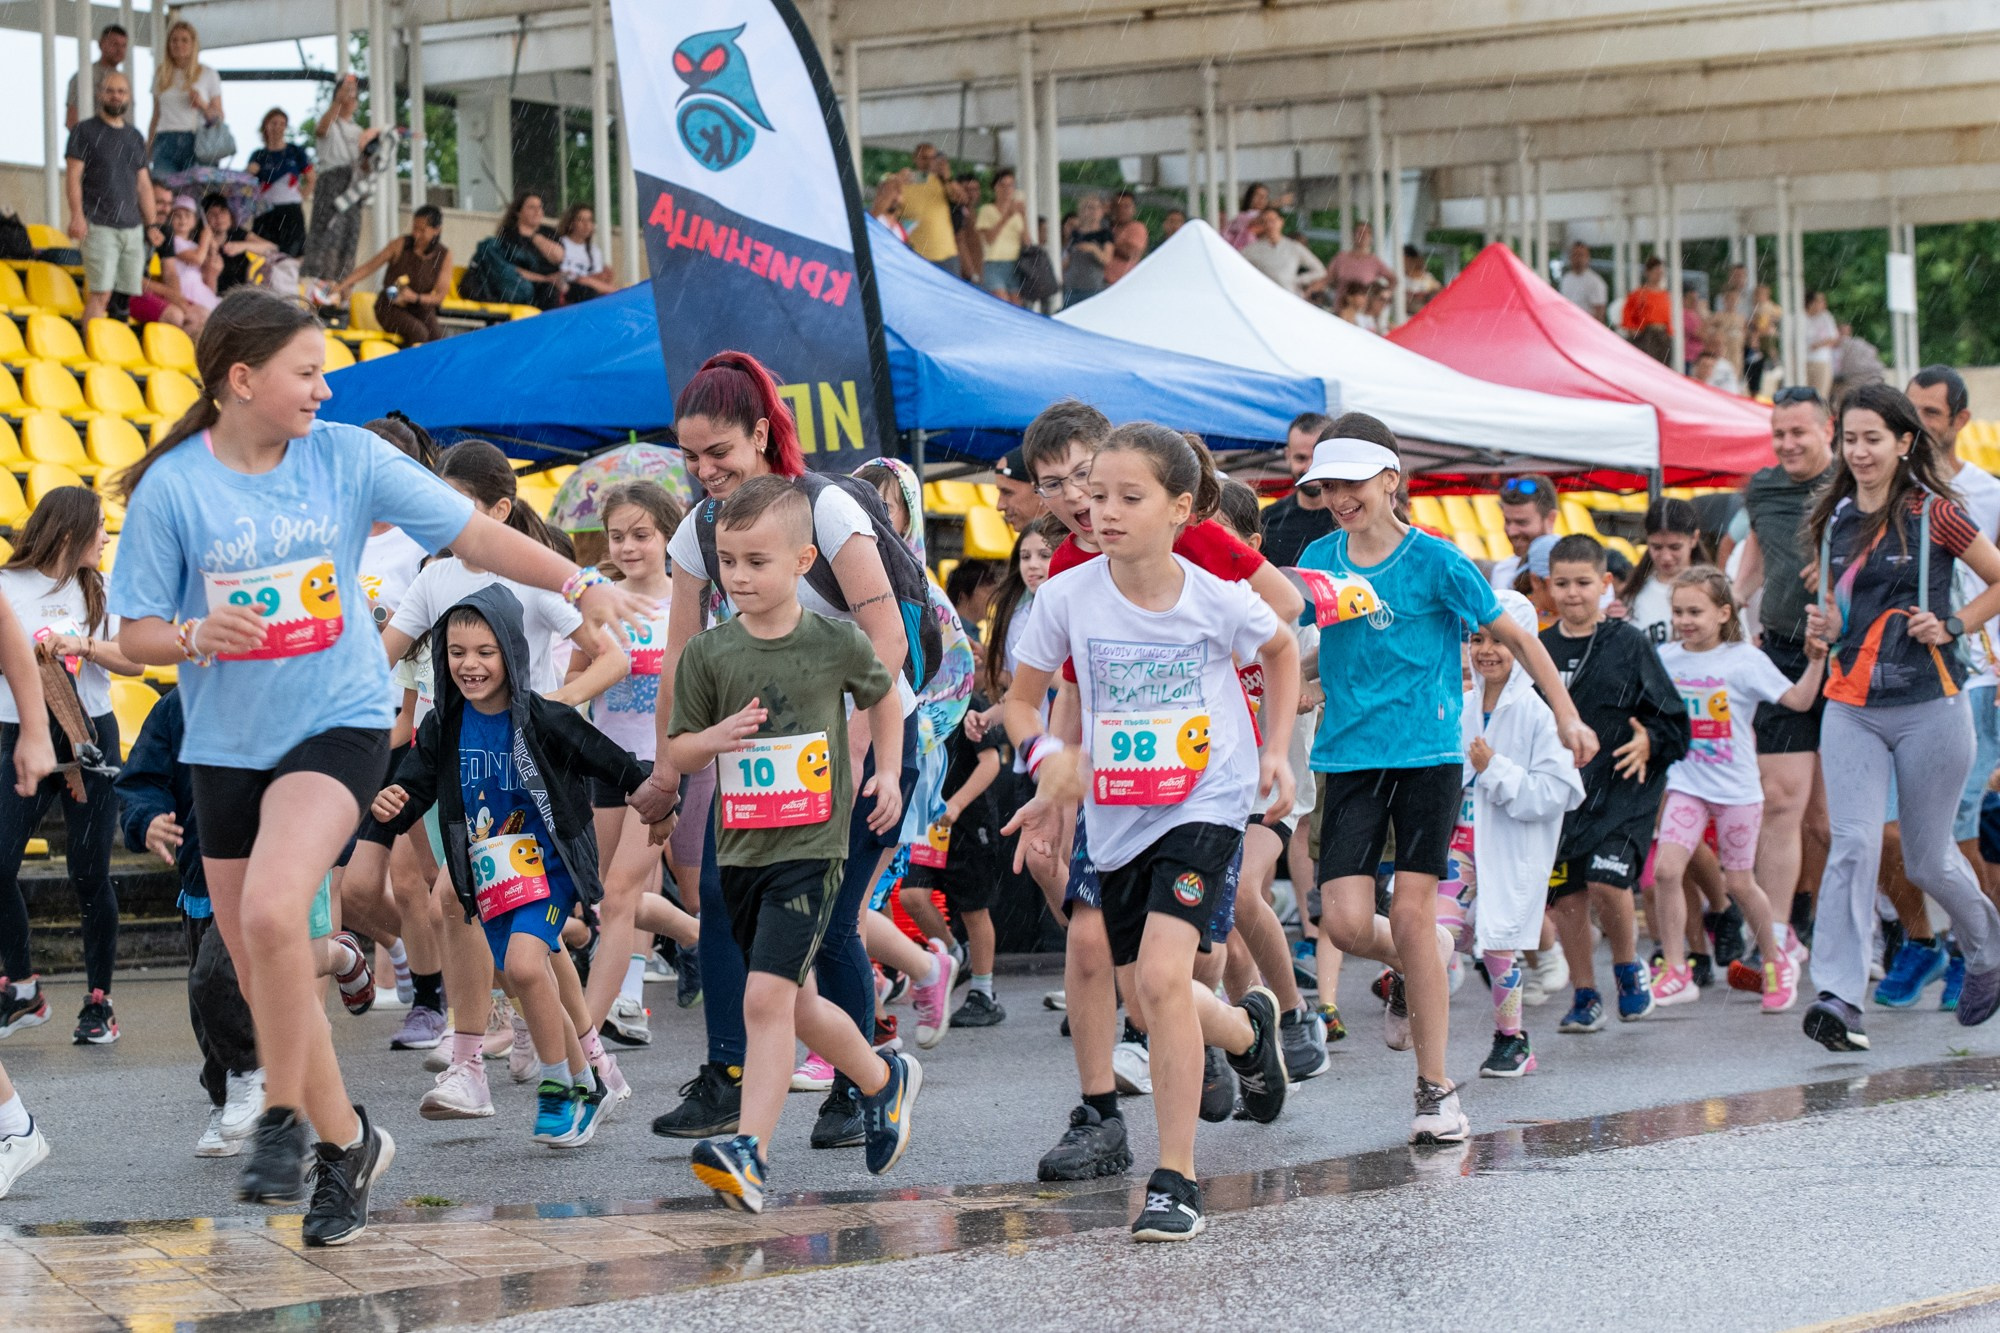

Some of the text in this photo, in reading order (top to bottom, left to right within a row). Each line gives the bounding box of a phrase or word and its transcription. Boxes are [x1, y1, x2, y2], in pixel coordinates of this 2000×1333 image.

[1099, 680, 1195, 703] TRIATHLON
[1111, 731, 1157, 762] 98
[738, 758, 775, 787] 10
